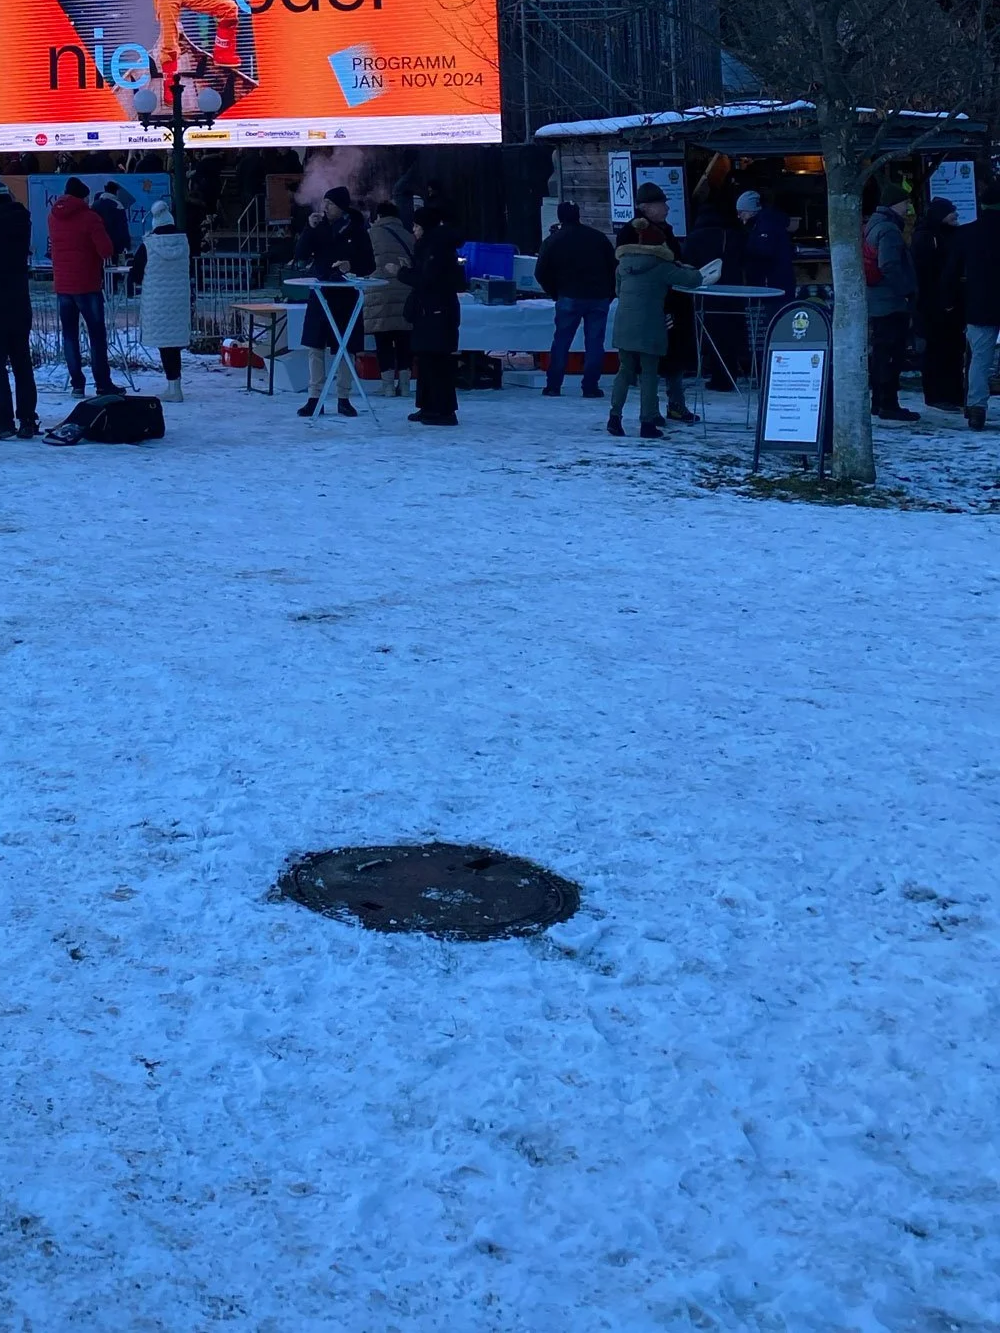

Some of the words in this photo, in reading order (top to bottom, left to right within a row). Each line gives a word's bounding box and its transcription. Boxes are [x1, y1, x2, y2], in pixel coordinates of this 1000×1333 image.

[48, 27, 151, 90] nie
[352, 55, 456, 71] PROGRAMM
[352, 74, 383, 89] JAN
[401, 73, 438, 87] NOV
[443, 72, 484, 87] 2024
[614, 209, 626, 219] Food
